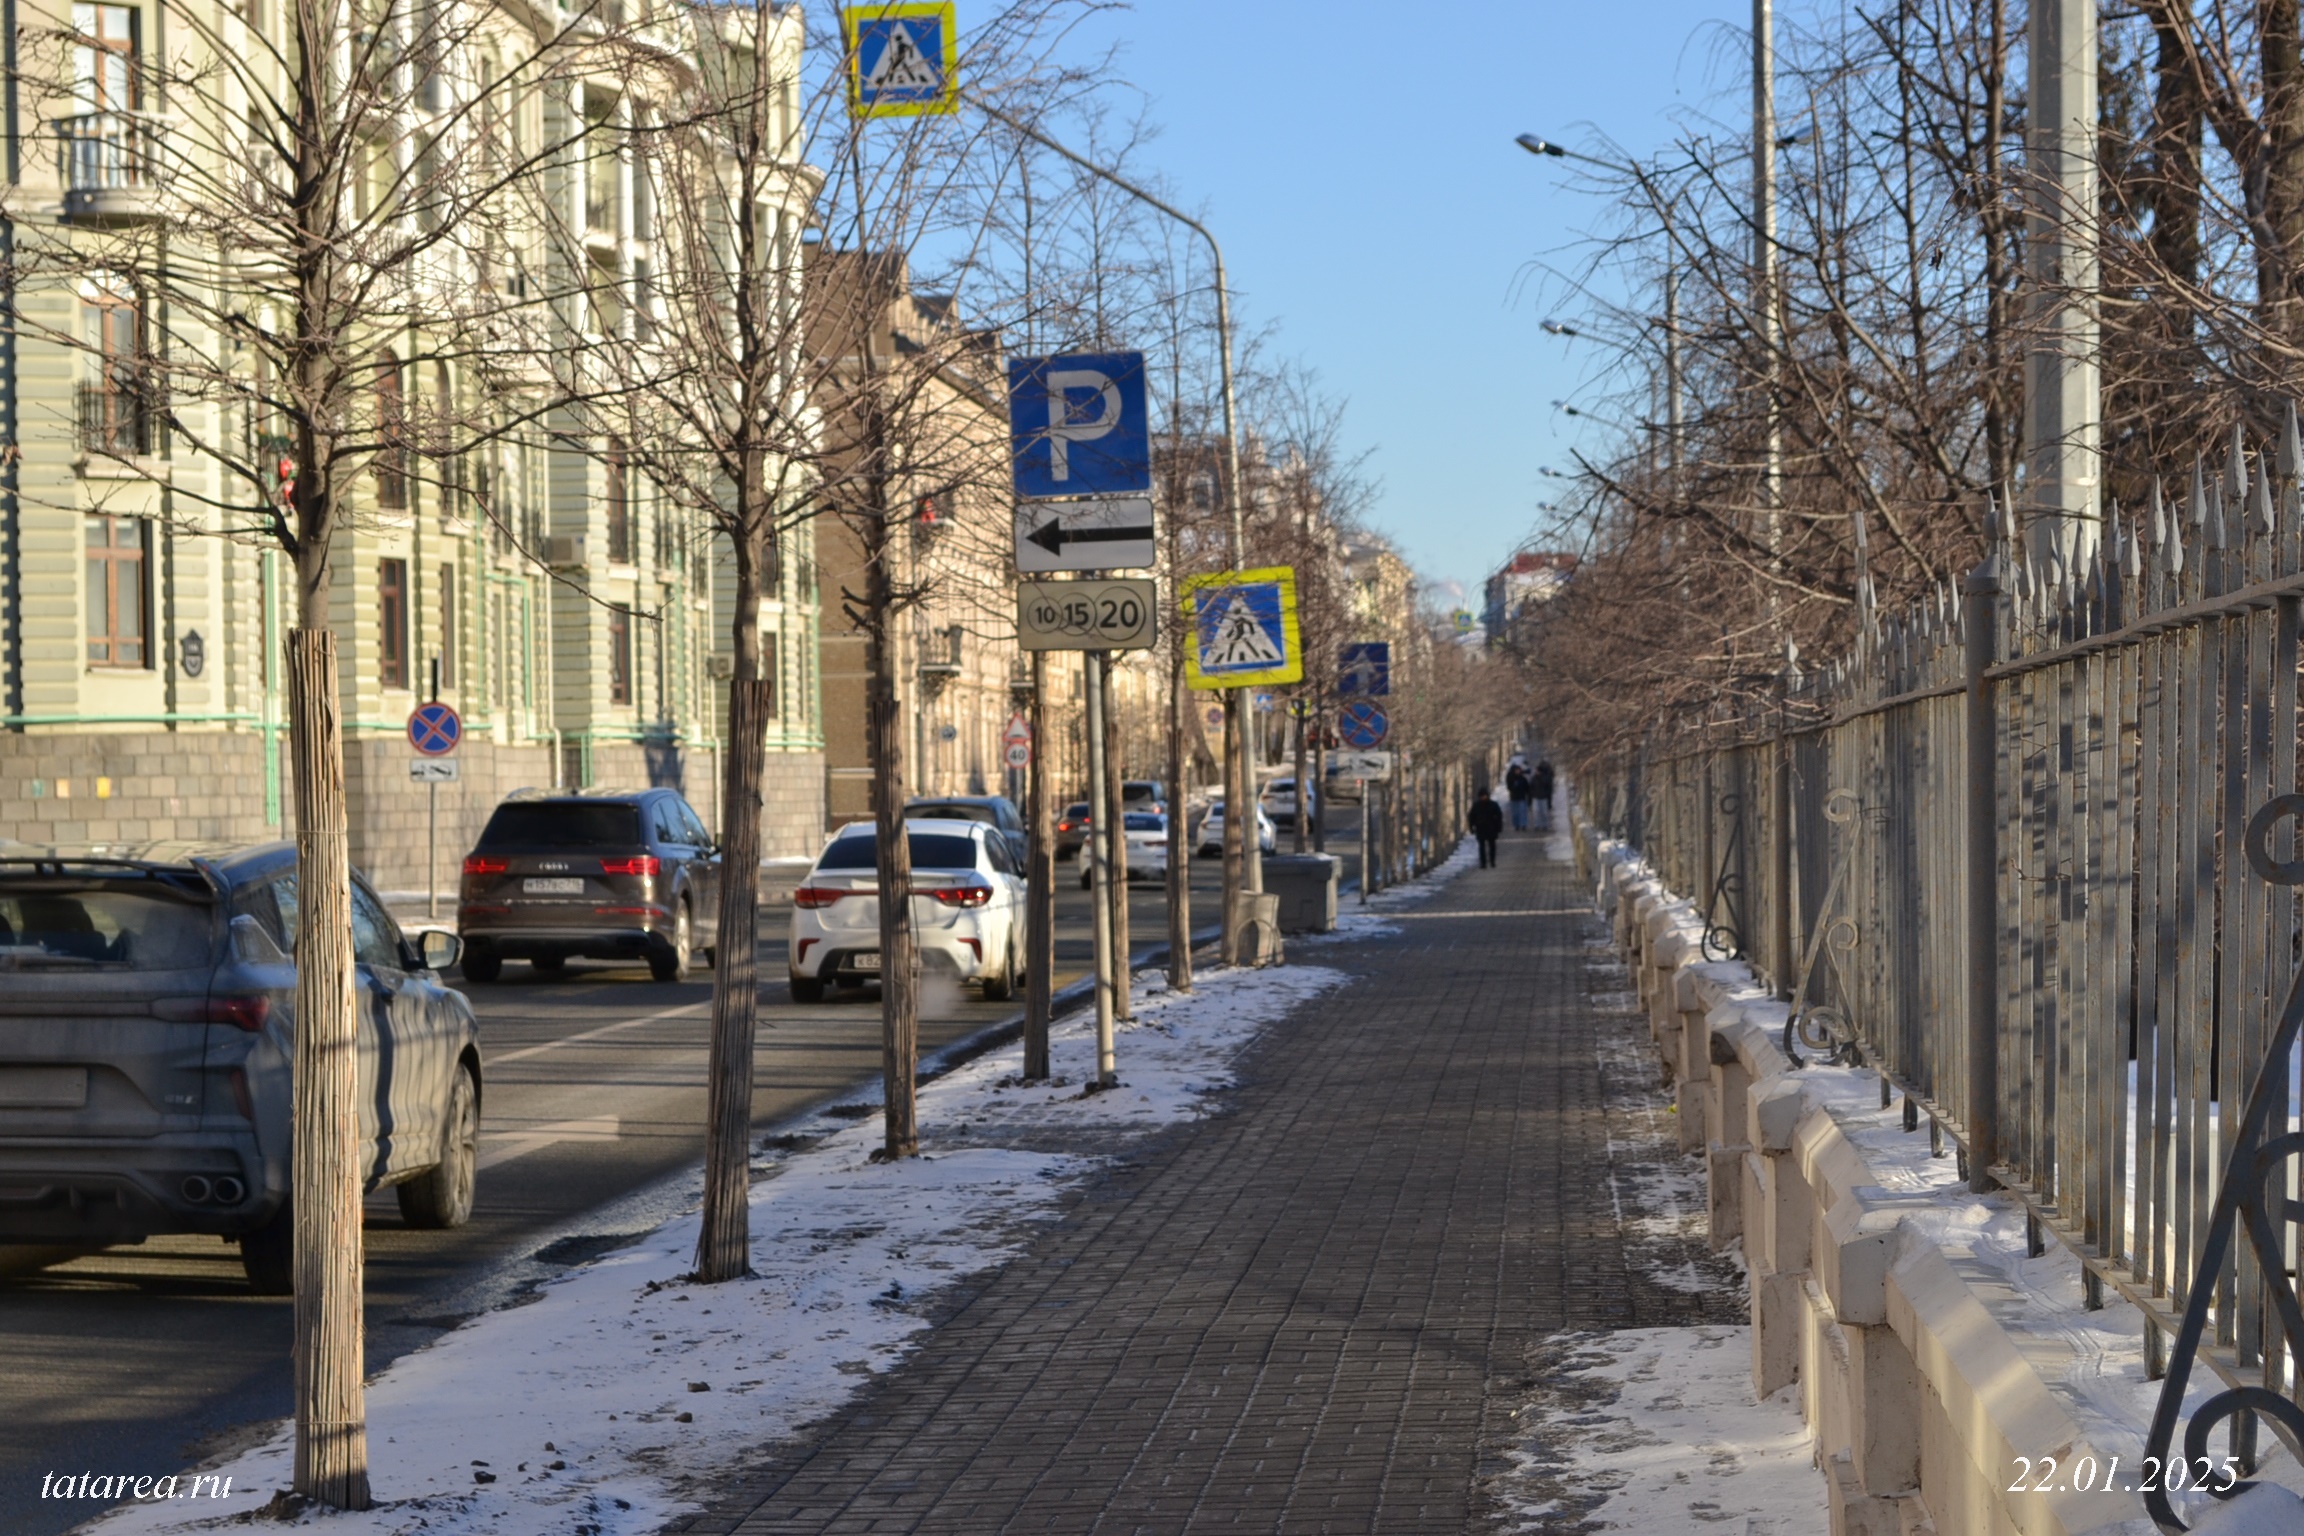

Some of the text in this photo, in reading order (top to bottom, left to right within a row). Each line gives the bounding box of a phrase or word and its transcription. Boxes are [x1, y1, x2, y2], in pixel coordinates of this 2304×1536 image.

[1047, 369, 1122, 481] P
[1035, 599, 1139, 628] 10 15 20
[1010, 749, 1026, 761] 40
